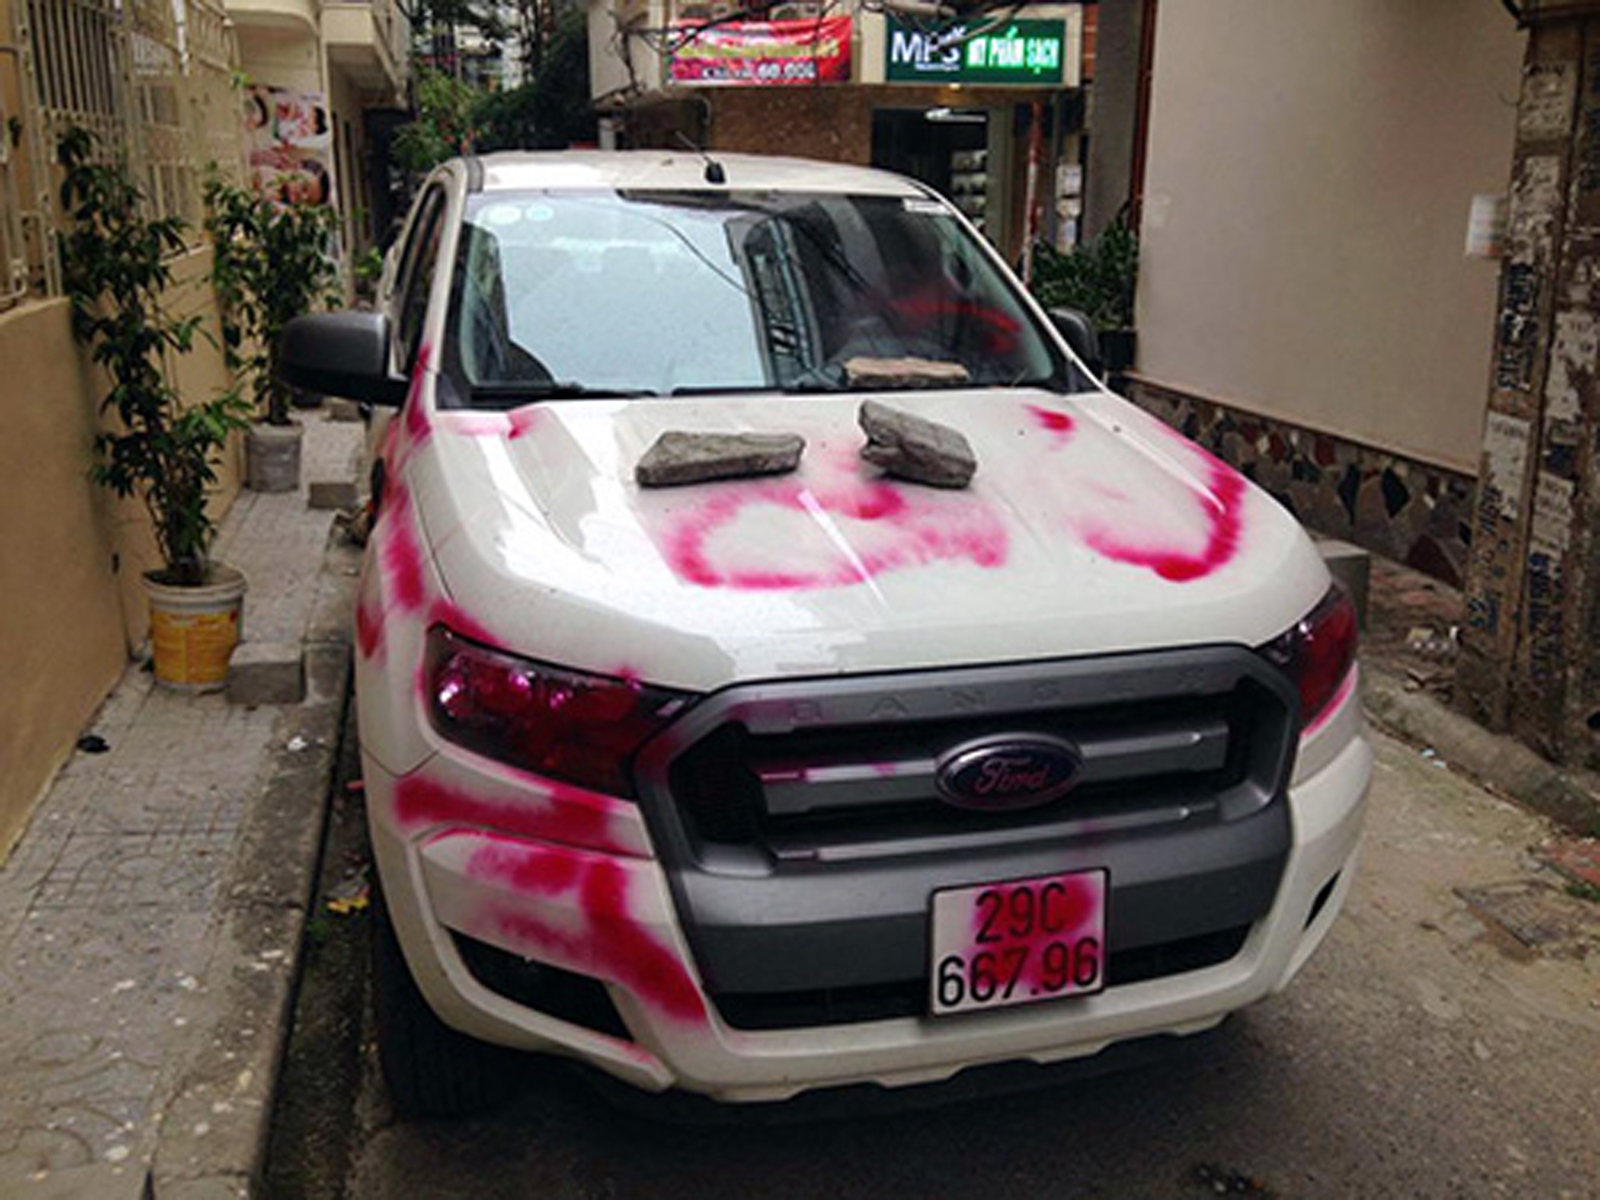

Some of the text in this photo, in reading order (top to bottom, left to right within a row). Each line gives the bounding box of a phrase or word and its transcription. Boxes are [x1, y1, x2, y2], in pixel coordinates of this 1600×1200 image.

[973, 757, 1051, 794] Ford
[975, 882, 1067, 944] 29C
[937, 936, 1099, 1007] 667.96
